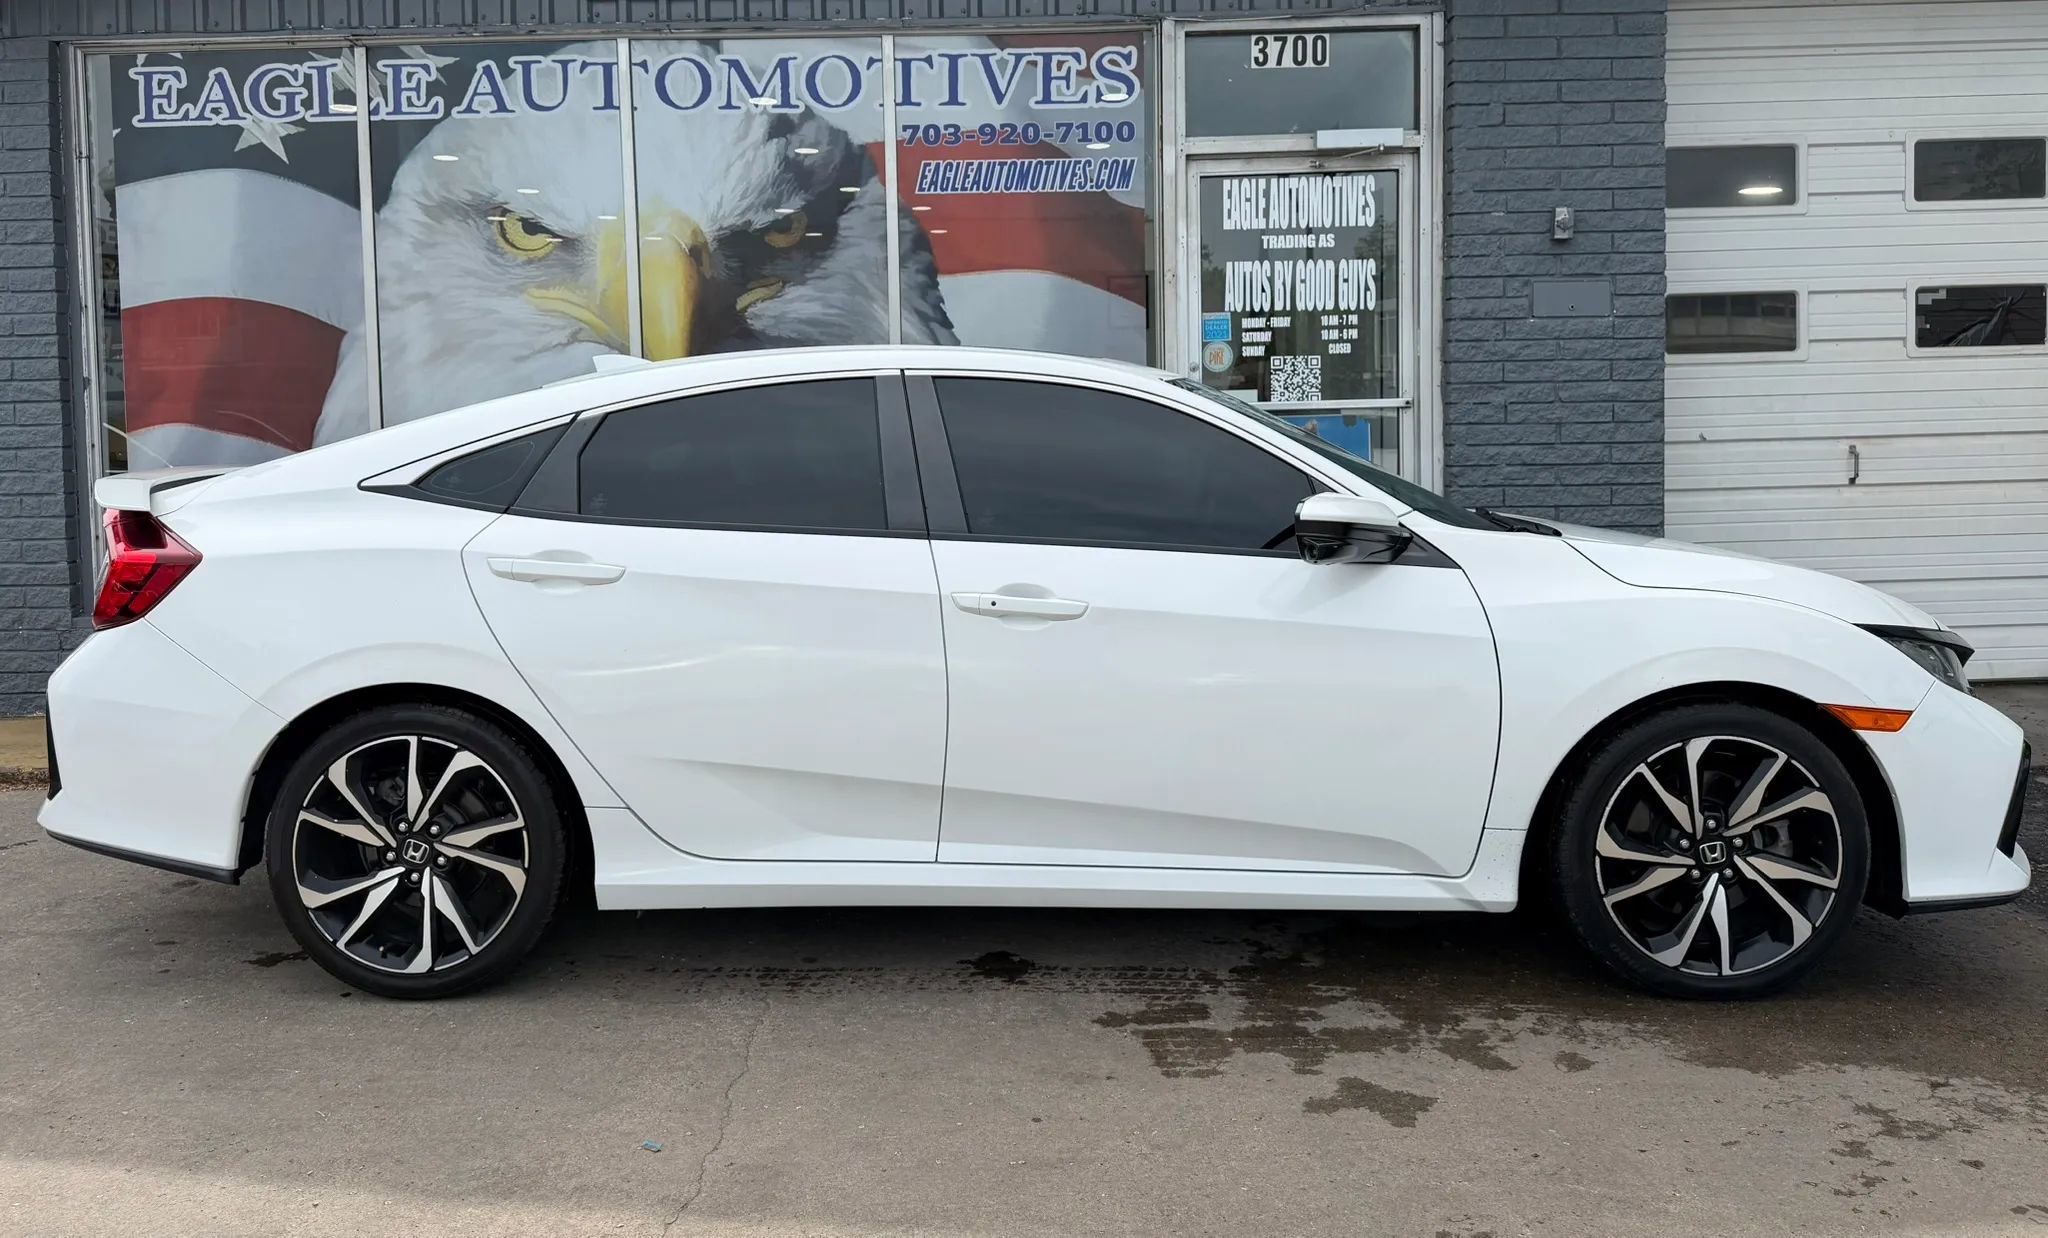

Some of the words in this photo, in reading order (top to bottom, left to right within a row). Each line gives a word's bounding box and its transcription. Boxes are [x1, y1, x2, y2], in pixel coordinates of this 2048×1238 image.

[1253, 34, 1328, 67] 3700
[131, 60, 442, 126] EAGLE
[454, 46, 1137, 117] AUTOMOTIVES
[902, 121, 1136, 147] 703-920-7100
[917, 157, 1137, 194] EAGLEAUTOMOTIVES.COM
[1223, 177, 1266, 230] EAGLE
[1268, 174, 1375, 229] AUTOMOTIVES
[1261, 234, 1316, 249] TRADING
[1318, 234, 1335, 249] AS
[1224, 260, 1271, 312] AUTOS
[1274, 260, 1293, 311] BY
[1295, 259, 1335, 312] GOOD
[1338, 258, 1376, 311] GUYS
[1242, 318, 1266, 328] MONDAY
[1270, 317, 1291, 327] FRIDAY
[1321, 315, 1328, 326] 10
[1329, 315, 1339, 326] AM
[1348, 314, 1358, 325] PM
[1242, 331, 1272, 342] SATURDAY
[1321, 329, 1328, 340] 10
[1329, 329, 1339, 340] AM
[1348, 329, 1358, 339] PM
[1242, 345, 1265, 356] SUNDAY
[1328, 343, 1351, 354] CLOSED
